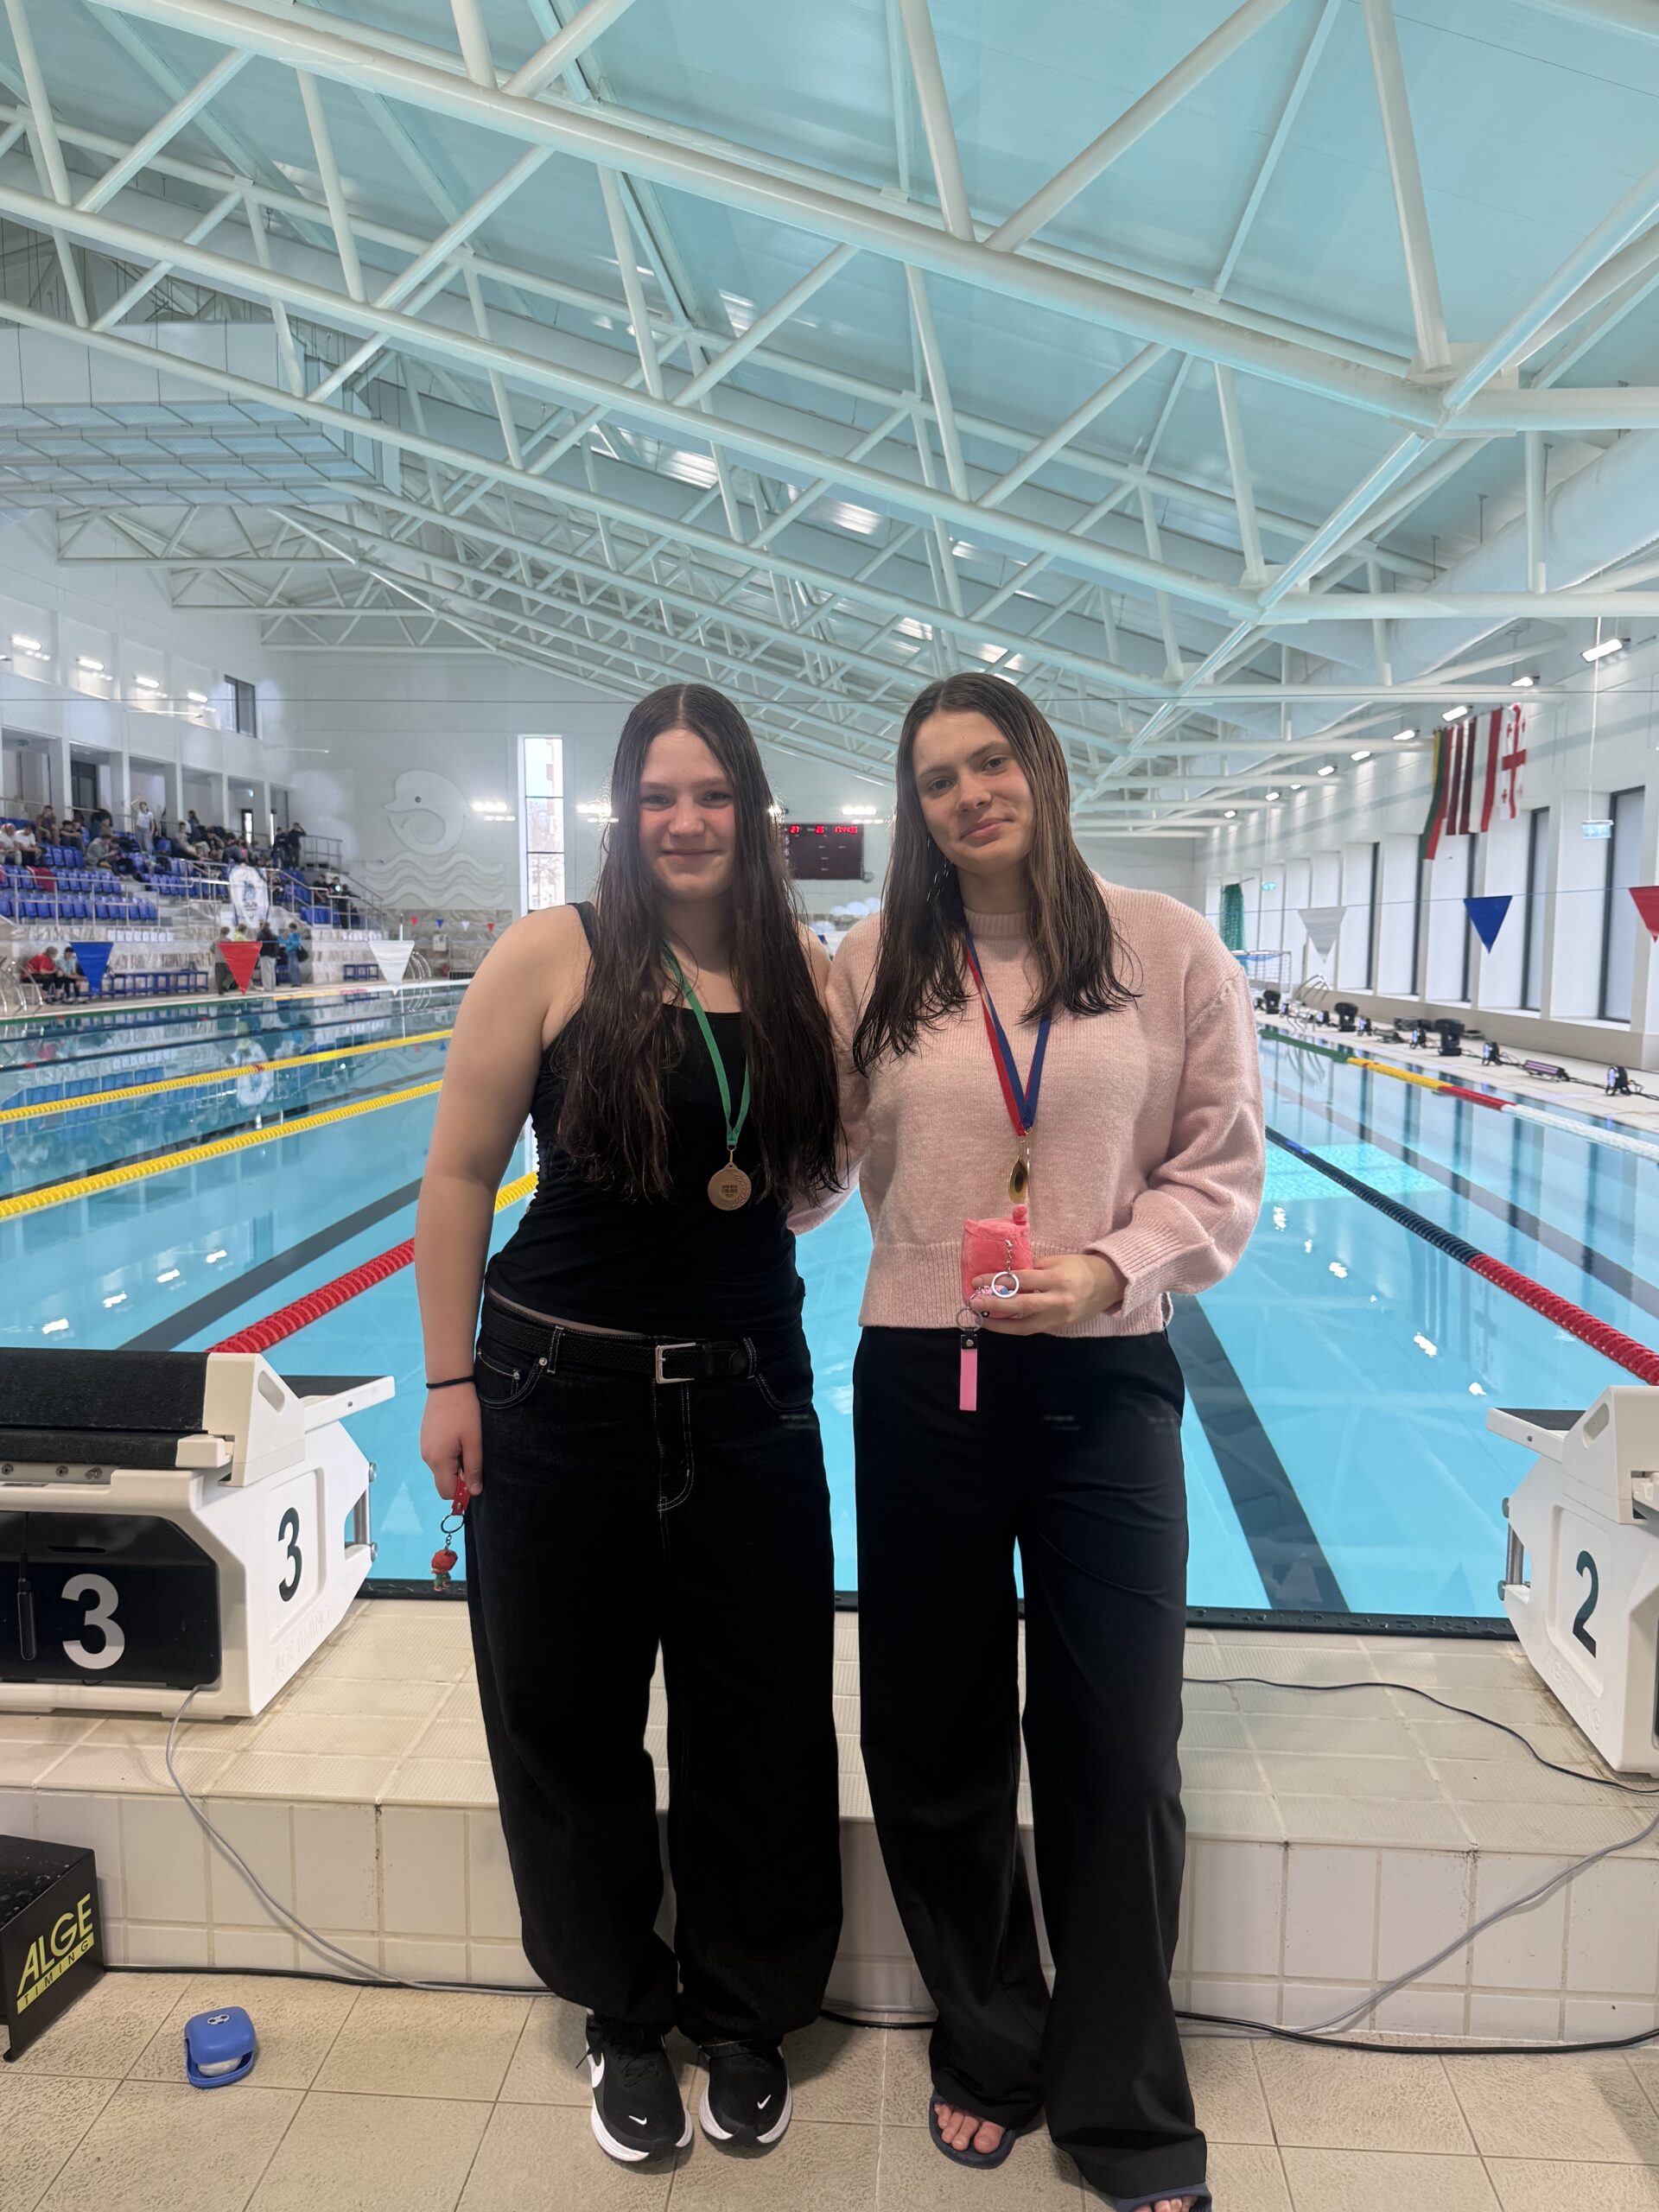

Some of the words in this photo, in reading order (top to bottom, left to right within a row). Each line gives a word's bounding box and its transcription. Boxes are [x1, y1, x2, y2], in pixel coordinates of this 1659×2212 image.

[277, 1507, 302, 1602] 3
[60, 1573, 125, 1670] 3
[1572, 1550, 1599, 1659] 2
[16, 1892, 93, 1998] ALGE
[23, 1939, 89, 2005] TIMING
